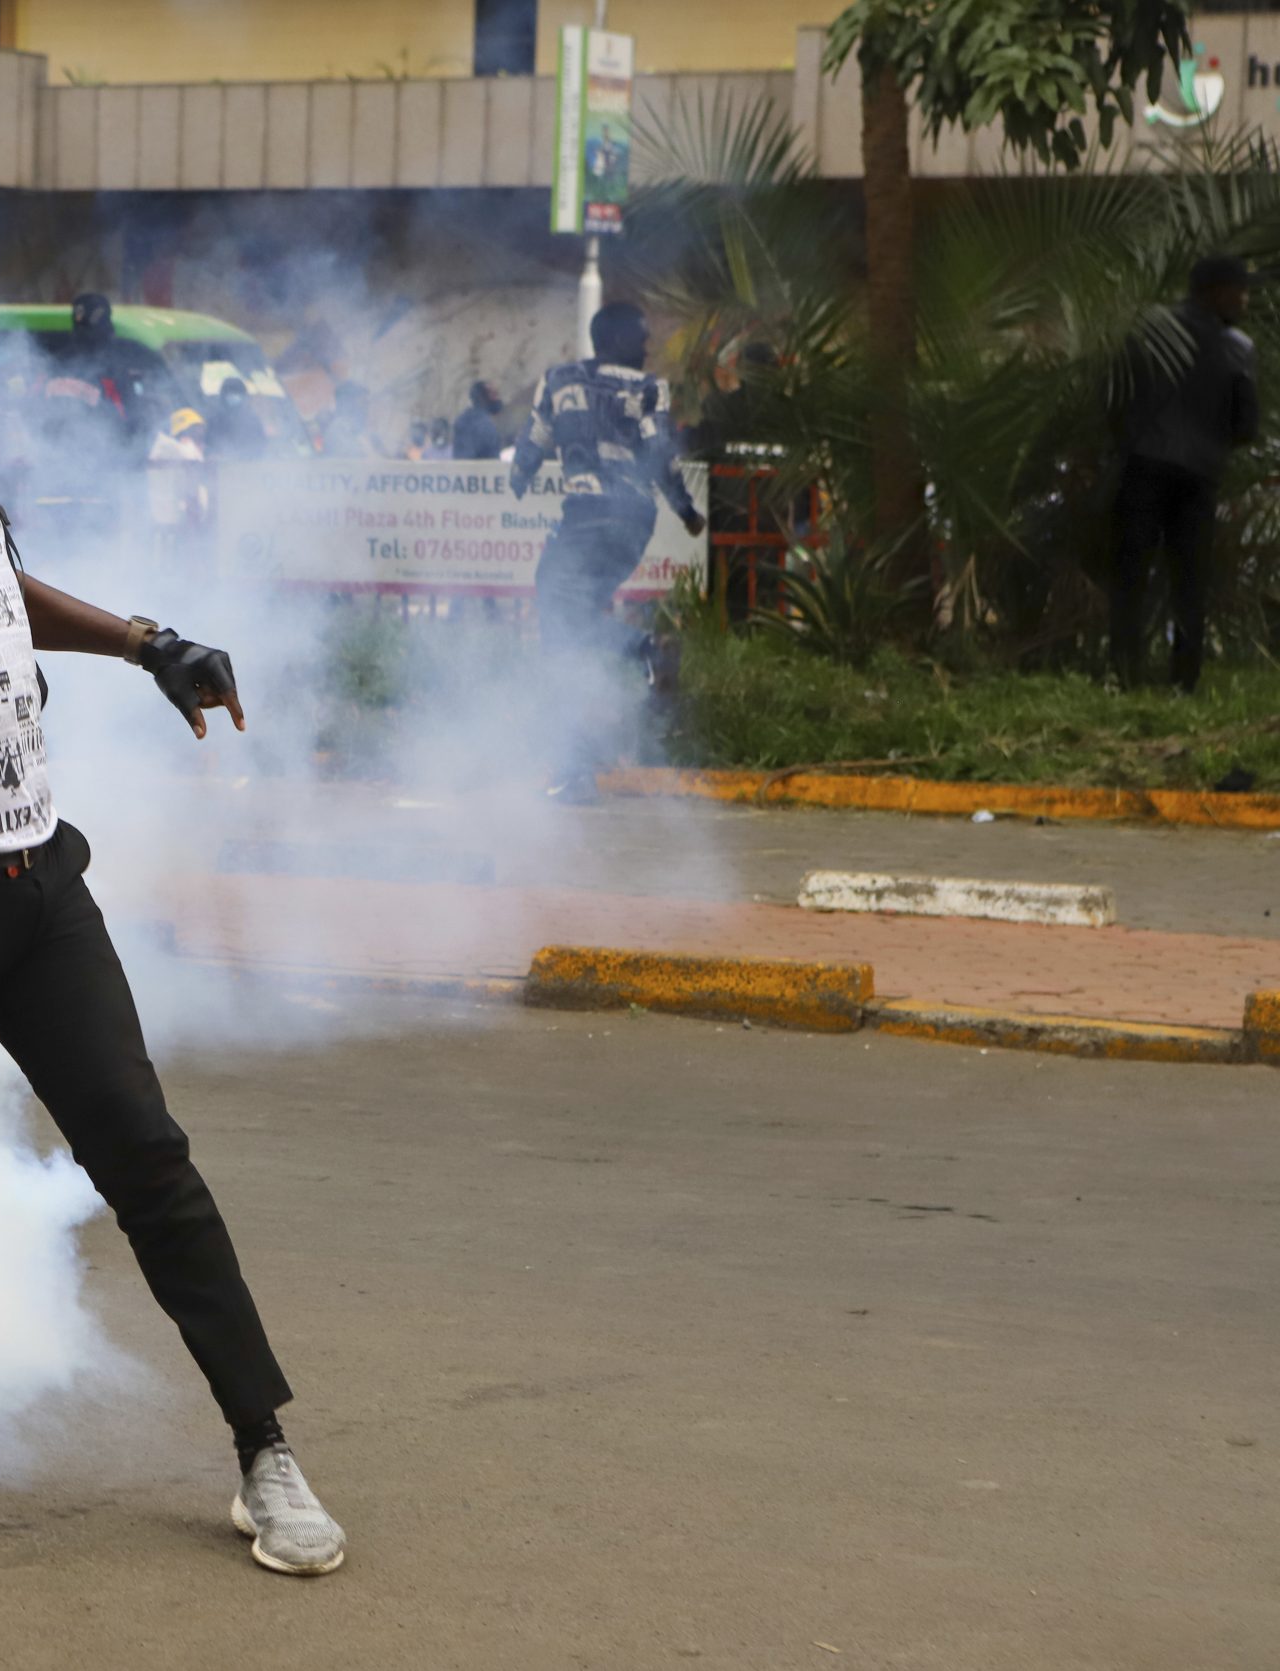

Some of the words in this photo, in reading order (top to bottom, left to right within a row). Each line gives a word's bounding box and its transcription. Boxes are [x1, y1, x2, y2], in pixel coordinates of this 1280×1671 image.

[365, 474, 505, 495] AFFORDABLE
[344, 507, 398, 529] Plaza
[403, 510, 436, 530] 4th
[441, 509, 496, 530] Floor
[367, 538, 408, 560] Tel:
[414, 540, 546, 561] 076500003
